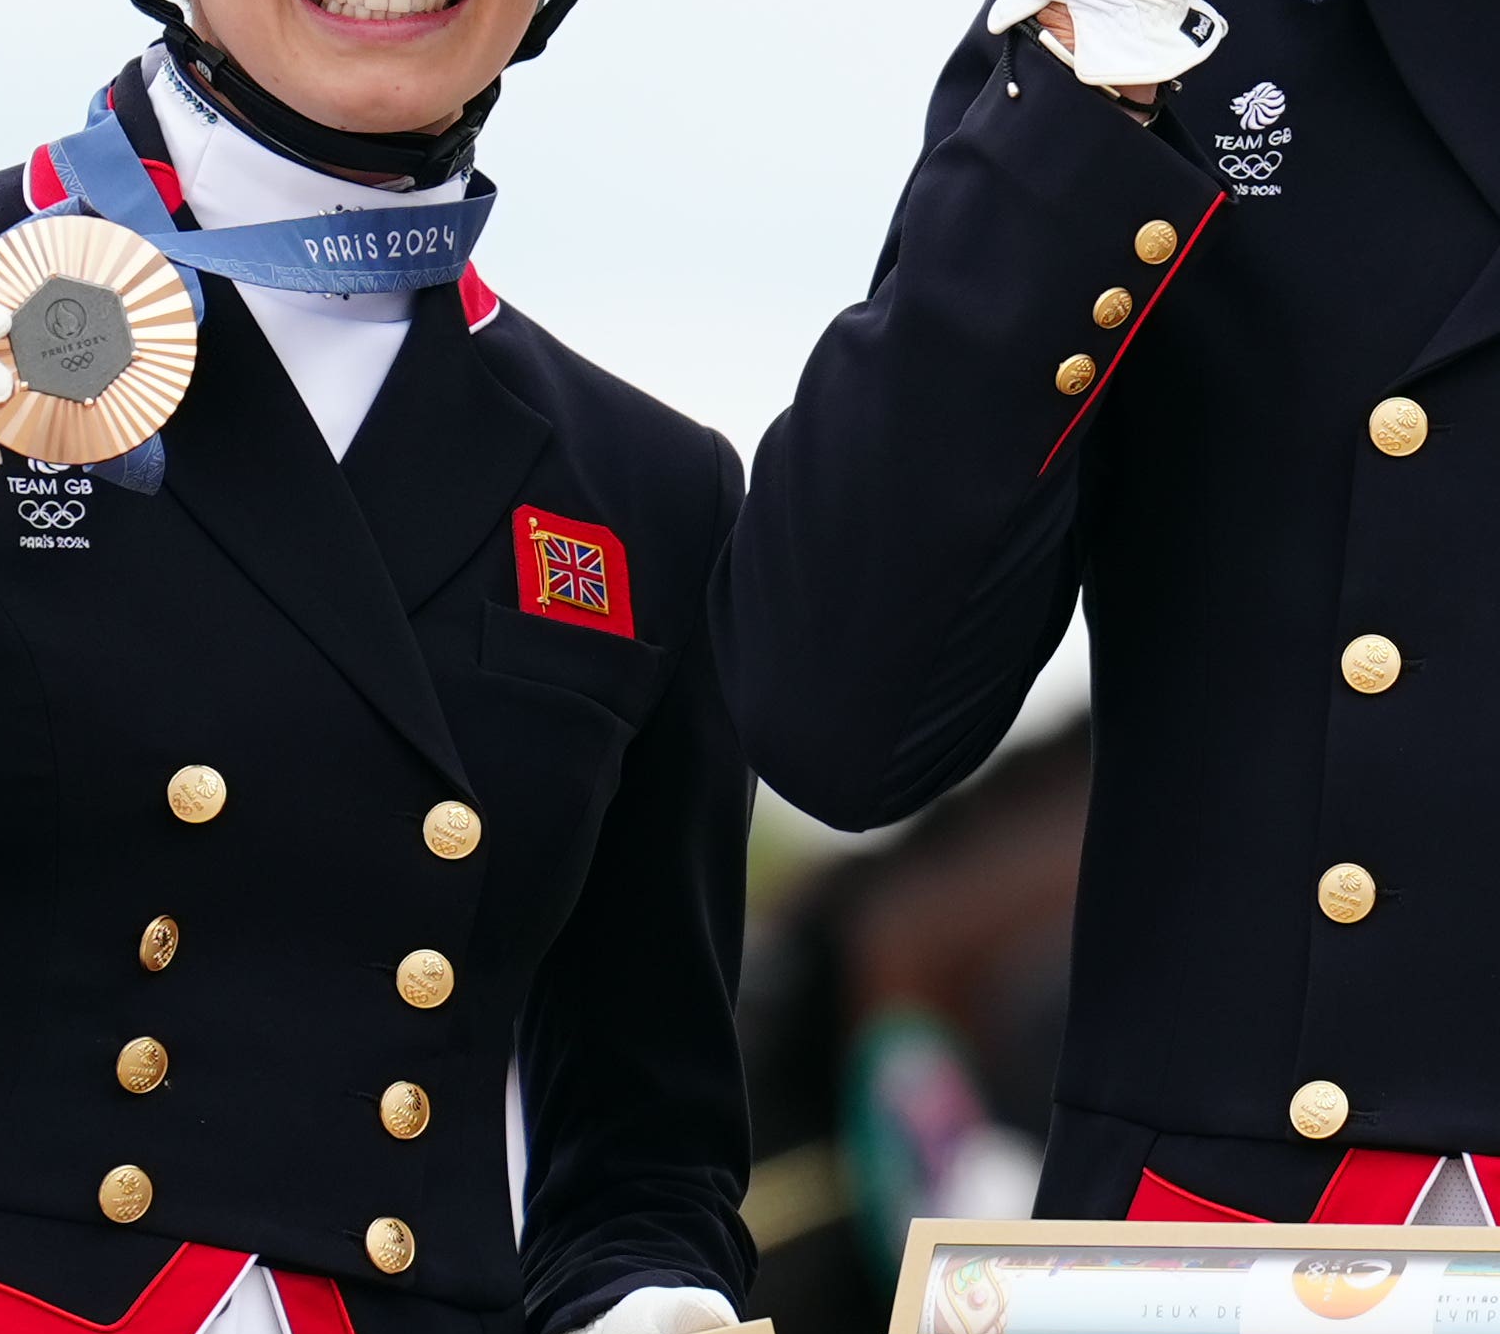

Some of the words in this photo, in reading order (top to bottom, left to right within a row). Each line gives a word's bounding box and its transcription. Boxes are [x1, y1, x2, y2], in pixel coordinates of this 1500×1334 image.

[1214, 134, 1263, 150] TEAM
[1268, 127, 1292, 146] GB
[1250, 185, 1282, 197] 2024
[386, 225, 454, 258] 2024
[6, 476, 58, 495] TEAM
[64, 478, 93, 495] GB
[56, 536, 90, 549] 2024
[1142, 1305, 1198, 1318] JEUX
